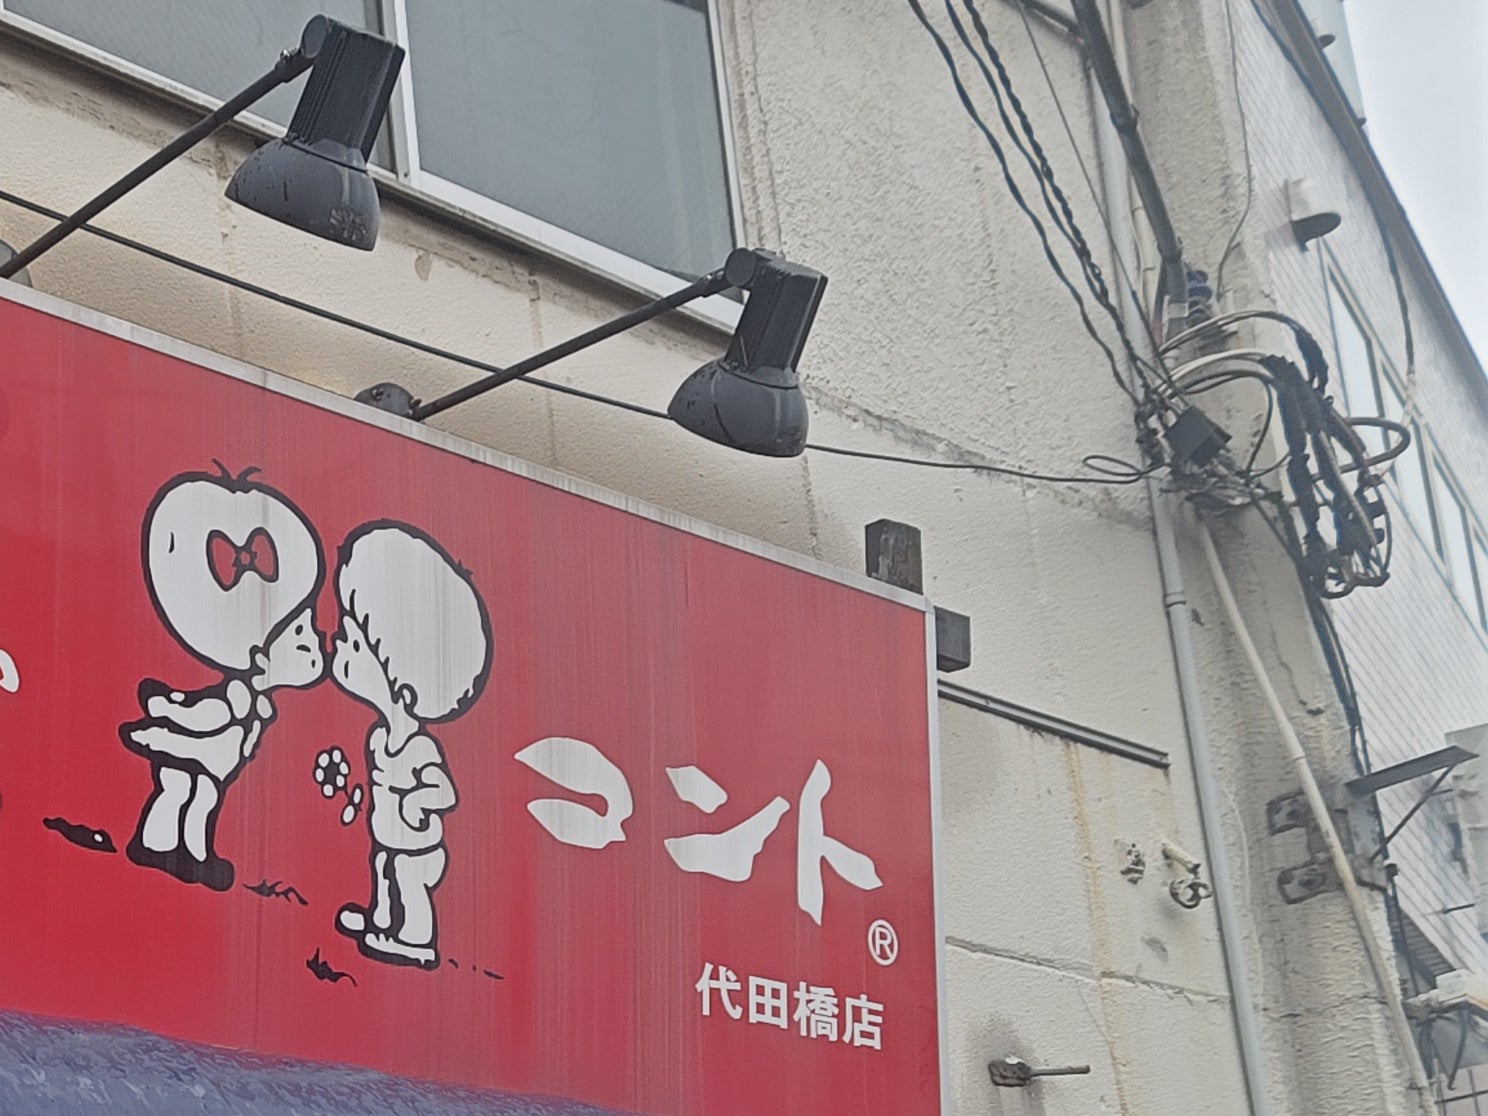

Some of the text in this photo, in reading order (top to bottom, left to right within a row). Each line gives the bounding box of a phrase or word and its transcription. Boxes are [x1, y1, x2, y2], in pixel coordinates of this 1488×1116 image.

[513, 736, 884, 927] コント
[694, 962, 885, 1050] 代田橋店
